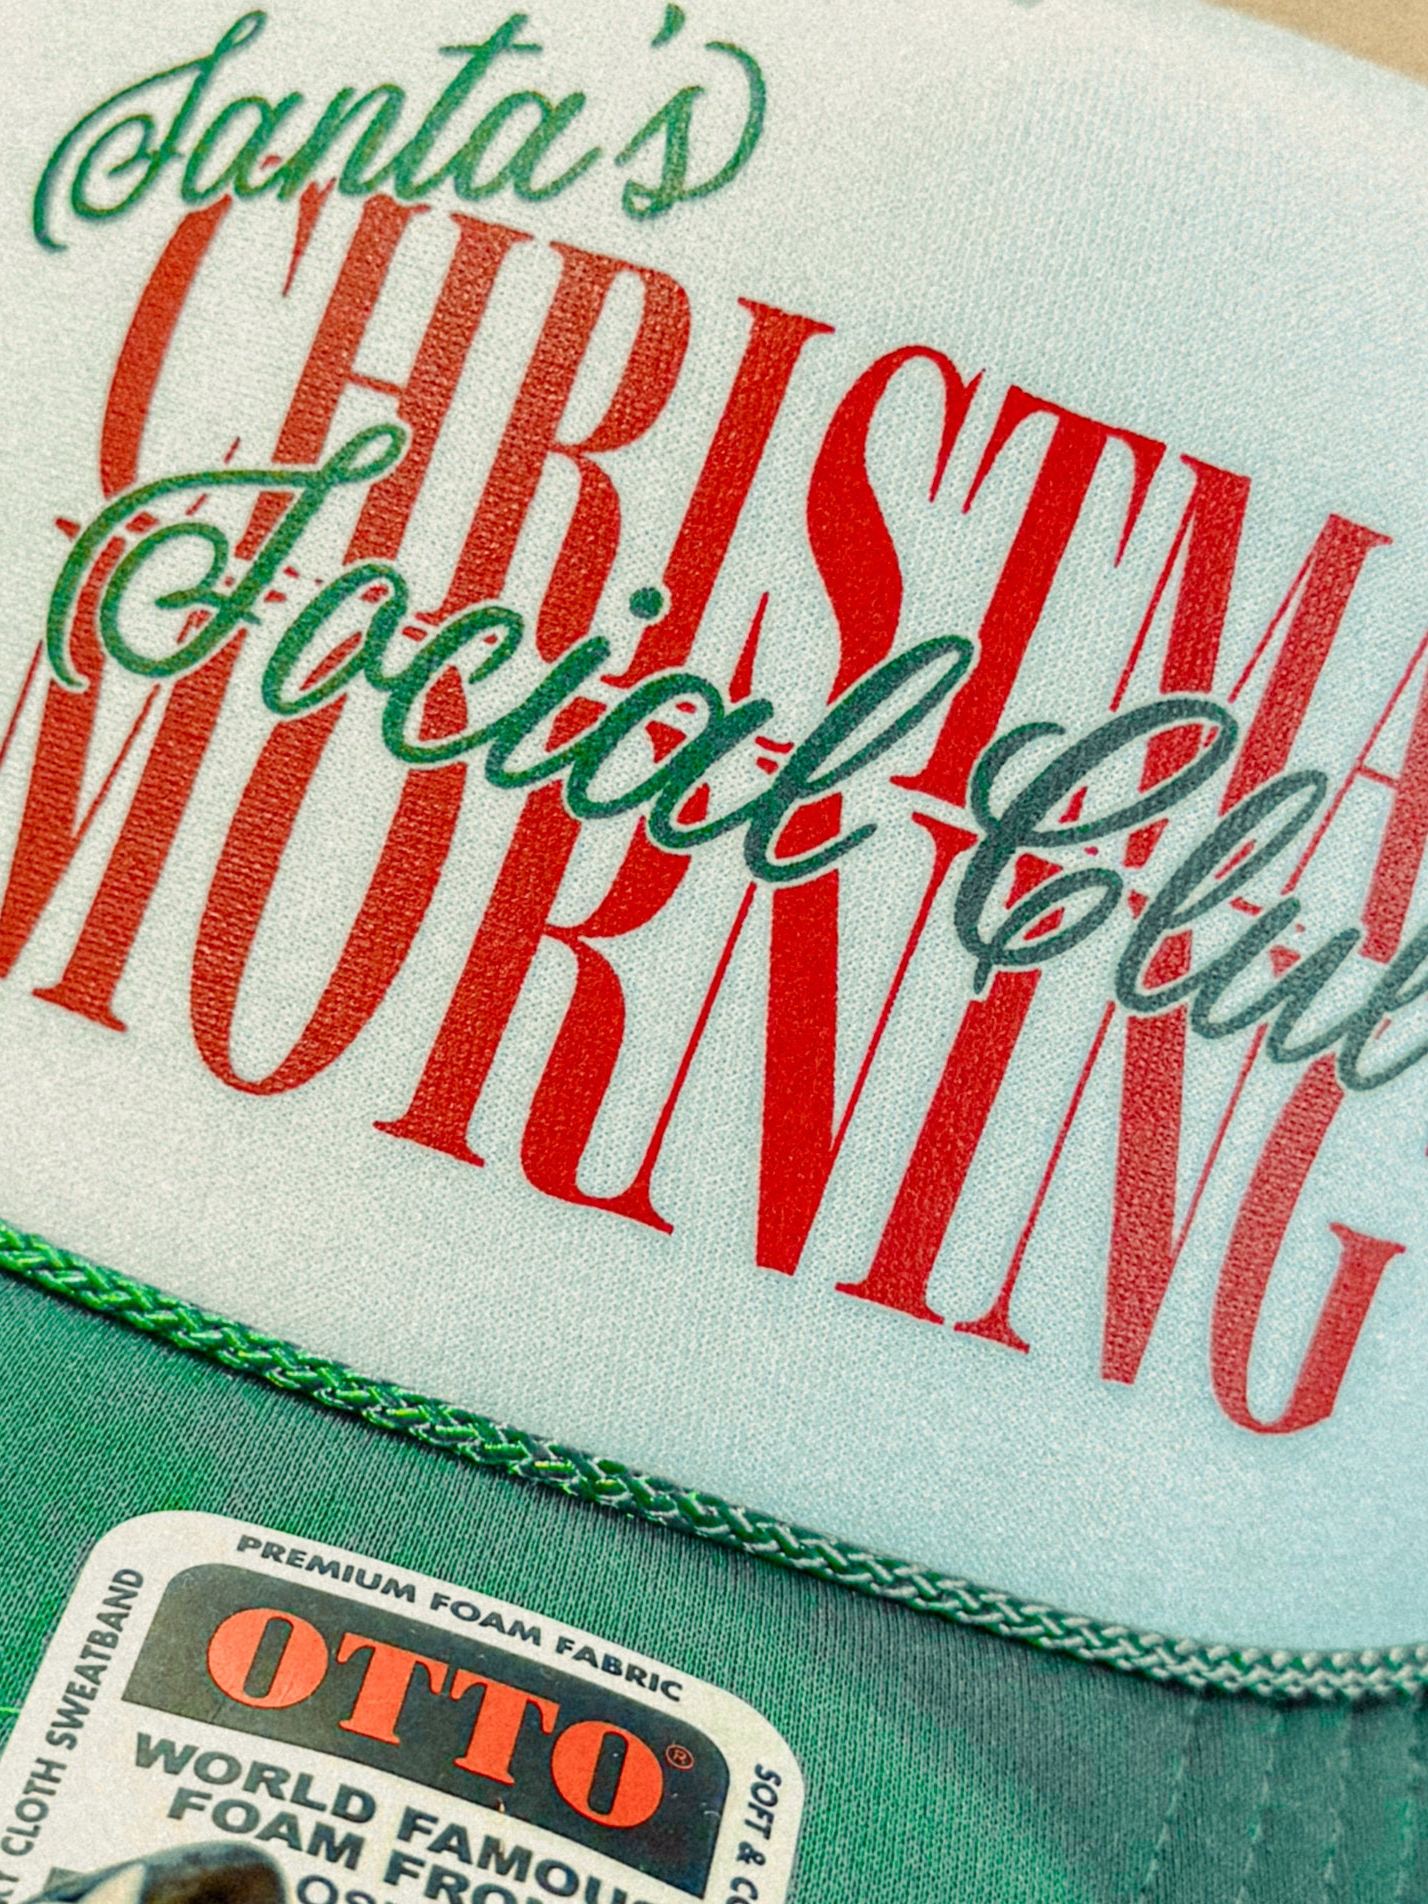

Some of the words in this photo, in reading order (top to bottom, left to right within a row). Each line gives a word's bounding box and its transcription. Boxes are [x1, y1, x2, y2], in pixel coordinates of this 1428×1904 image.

[33, 4, 768, 252] Santa's
[46, 424, 972, 882] Social
[236, 1534, 416, 1604] PREMIUM
[430, 1592, 542, 1647] FOAM
[556, 1636, 684, 1702] FABRIC
[1, 1757, 68, 1857] CLOTH
[46, 1568, 145, 1751] SWEATBAND
[134, 1731, 377, 1826] WORLD
[206, 1607, 664, 1829] OTTO
[166, 1786, 366, 1871] FOAM
[736, 1840, 767, 1867] &
[743, 1763, 783, 1840] SOFT
